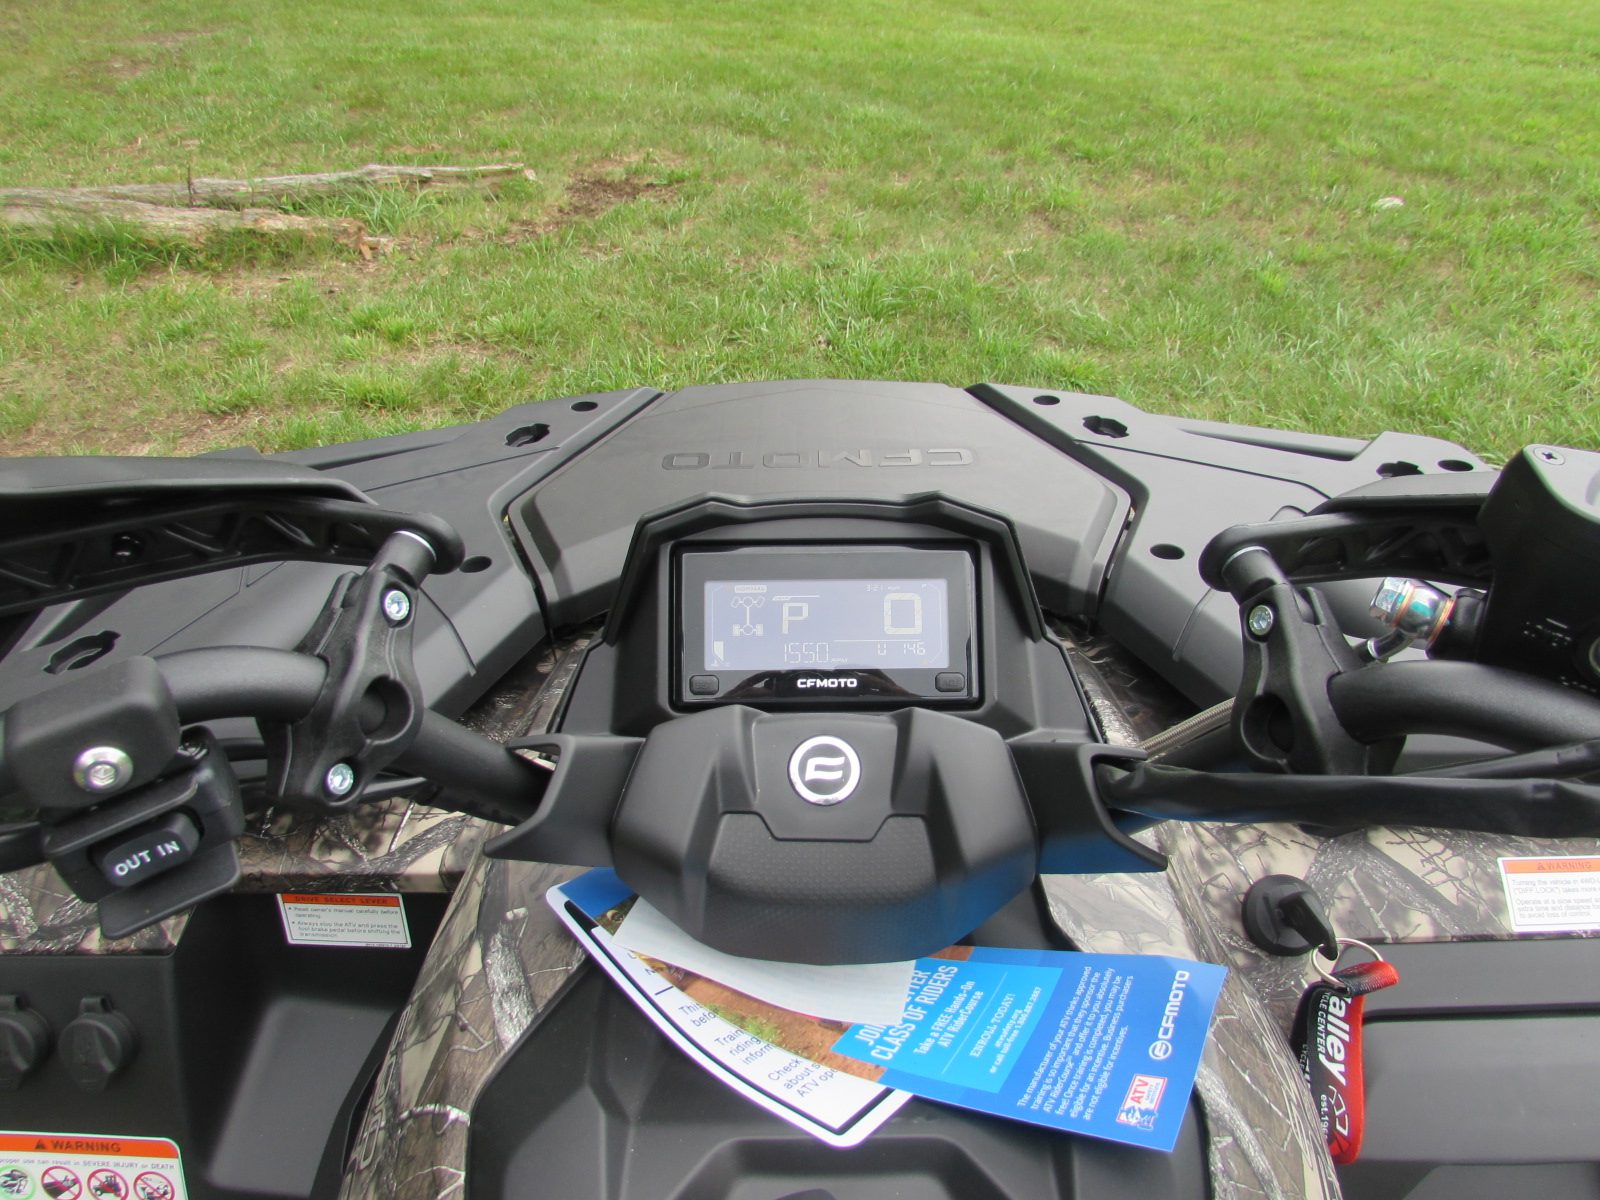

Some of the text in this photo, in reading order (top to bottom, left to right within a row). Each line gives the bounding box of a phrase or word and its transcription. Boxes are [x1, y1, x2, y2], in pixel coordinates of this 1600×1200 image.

[662, 448, 976, 470] CFMOTO
[782, 602, 808, 634] P
[884, 593, 922, 634] 0
[785, 642, 829, 663] 1550
[797, 678, 858, 688] CFMOTO
[115, 841, 180, 876] OUT IN
[1096, 968, 1115, 1000] absolutely
[1108, 985, 1121, 999] may
[870, 966, 958, 1060] CLASS OF RIDERS
[1092, 1000, 1101, 1013] you
[1104, 1000, 1113, 1013] you
[1158, 970, 1190, 1040] CFMOTO
[938, 992, 983, 1047] ATV RiderCourse
[970, 994, 1015, 1057] ENROLL TODAY!
[914, 1038, 935, 1054] Take
[931, 1014, 952, 1031] FREE
[1017, 1094, 1031, 1106] The
[1026, 1051, 1053, 1093] manufacturer
[1054, 1029, 1064, 1044] your
[1060, 1016, 1071, 1028] ATV
[1066, 996, 1080, 1015] thinks
[1076, 967, 1092, 996] approved
[1031, 1084, 1052, 1110] training
[1053, 1038, 1073, 1068] important
[1068, 1024, 1079, 1037] that
[1074, 1009, 1088, 1024] they
[1081, 984, 1095, 1008] sponsor
[1091, 972, 1101, 983] the
[1078, 1027, 1090, 1043] offer
[1317, 1011, 1326, 1054] CENTER
[1318, 996, 1352, 1086] alley
[729, 1036, 761, 1056] riding
[1070, 1094, 1086, 1118] eligible
[1079, 1082, 1091, 1093] for
[1103, 1012, 1121, 1041] Business
[1116, 976, 1133, 1011] purchasers
[1073, 1043, 1083, 1055] and
[768, 1058, 803, 1080] Check
[1073, 1055, 1093, 1080] training
[1103, 1060, 1114, 1071] for
[784, 1067, 814, 1089] about
[797, 1079, 819, 1097] ATV
[1063, 1080, 1079, 1098] Once
[1094, 1071, 1110, 1094] eligible
[1089, 1095, 1100, 1108] not
[1130, 1078, 1149, 1104] ATV
[1043, 1098, 1056, 1112] ATV
[1083, 1108, 1094, 1120] are
[51, 1141, 121, 1153] WARNING
